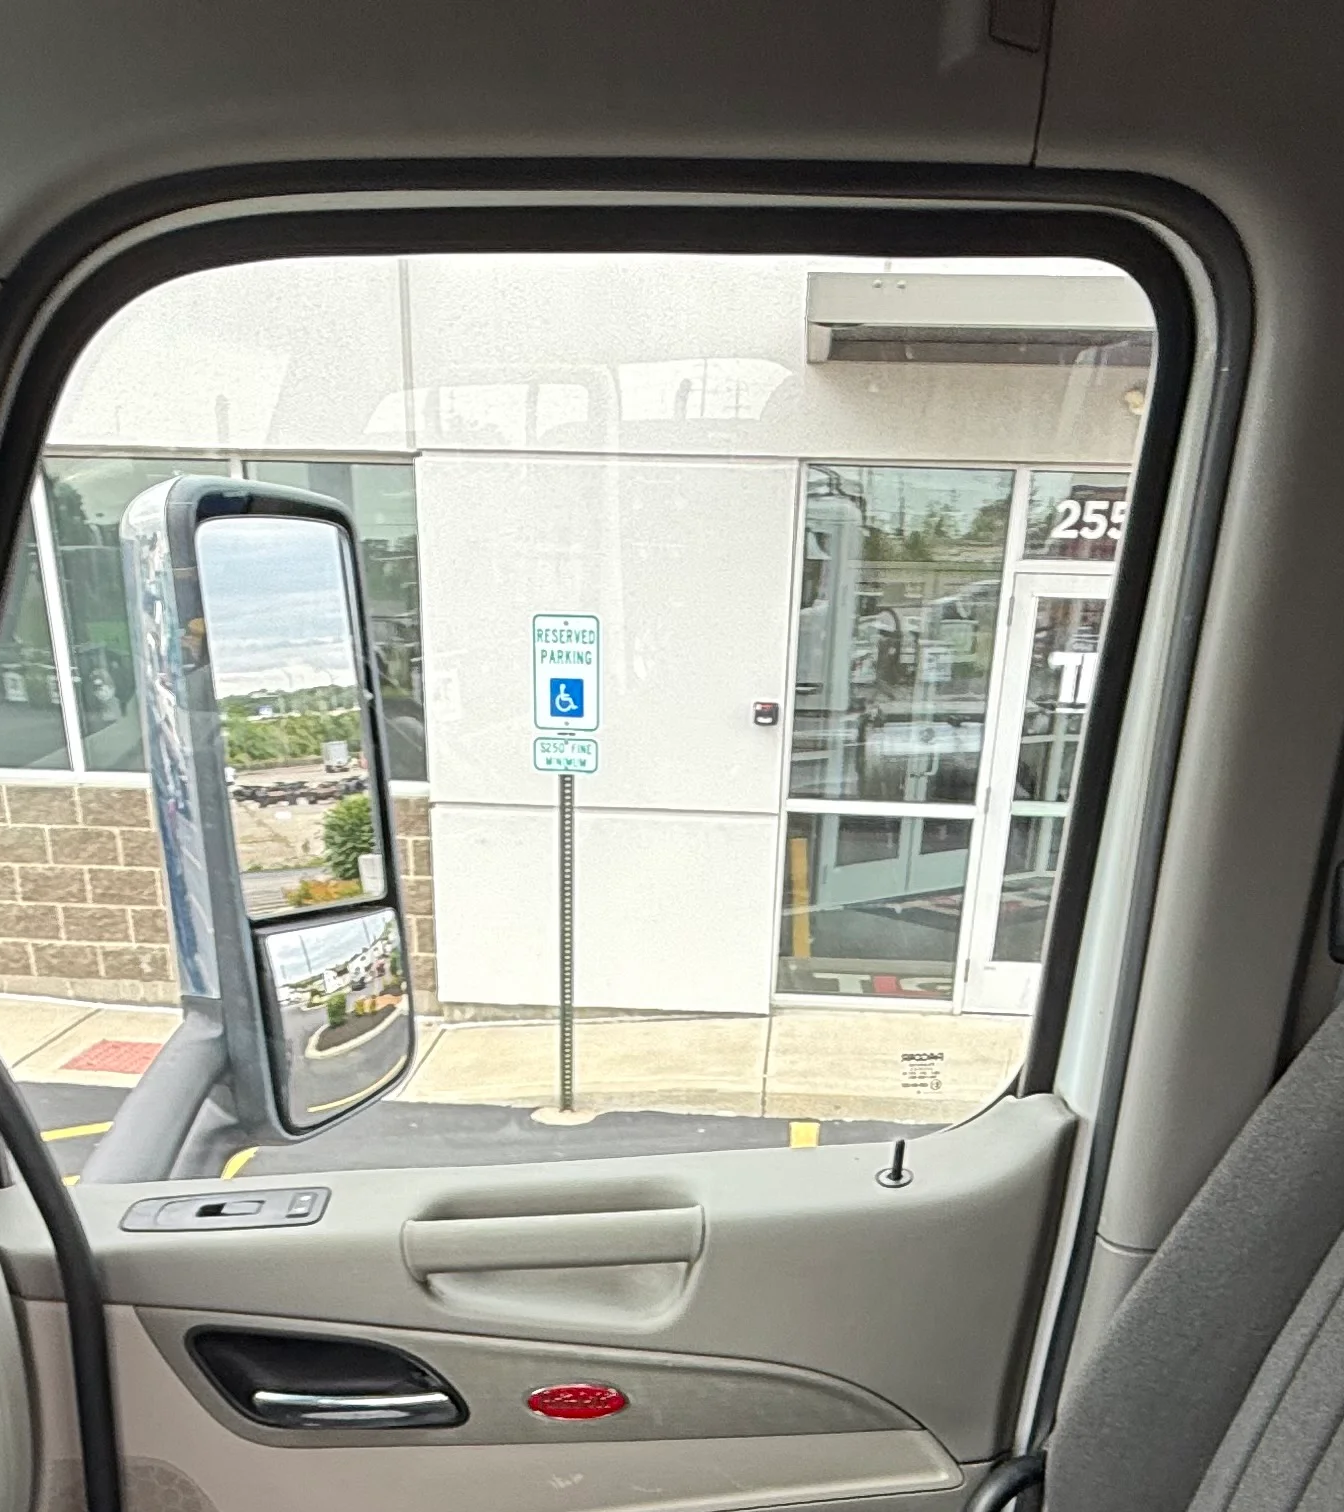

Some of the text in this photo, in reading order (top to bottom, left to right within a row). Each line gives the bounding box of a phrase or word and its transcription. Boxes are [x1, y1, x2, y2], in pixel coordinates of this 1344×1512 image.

[536, 628, 596, 645] RESERVED
[540, 649, 593, 665] PARKING
[571, 743, 592, 755] FINE
